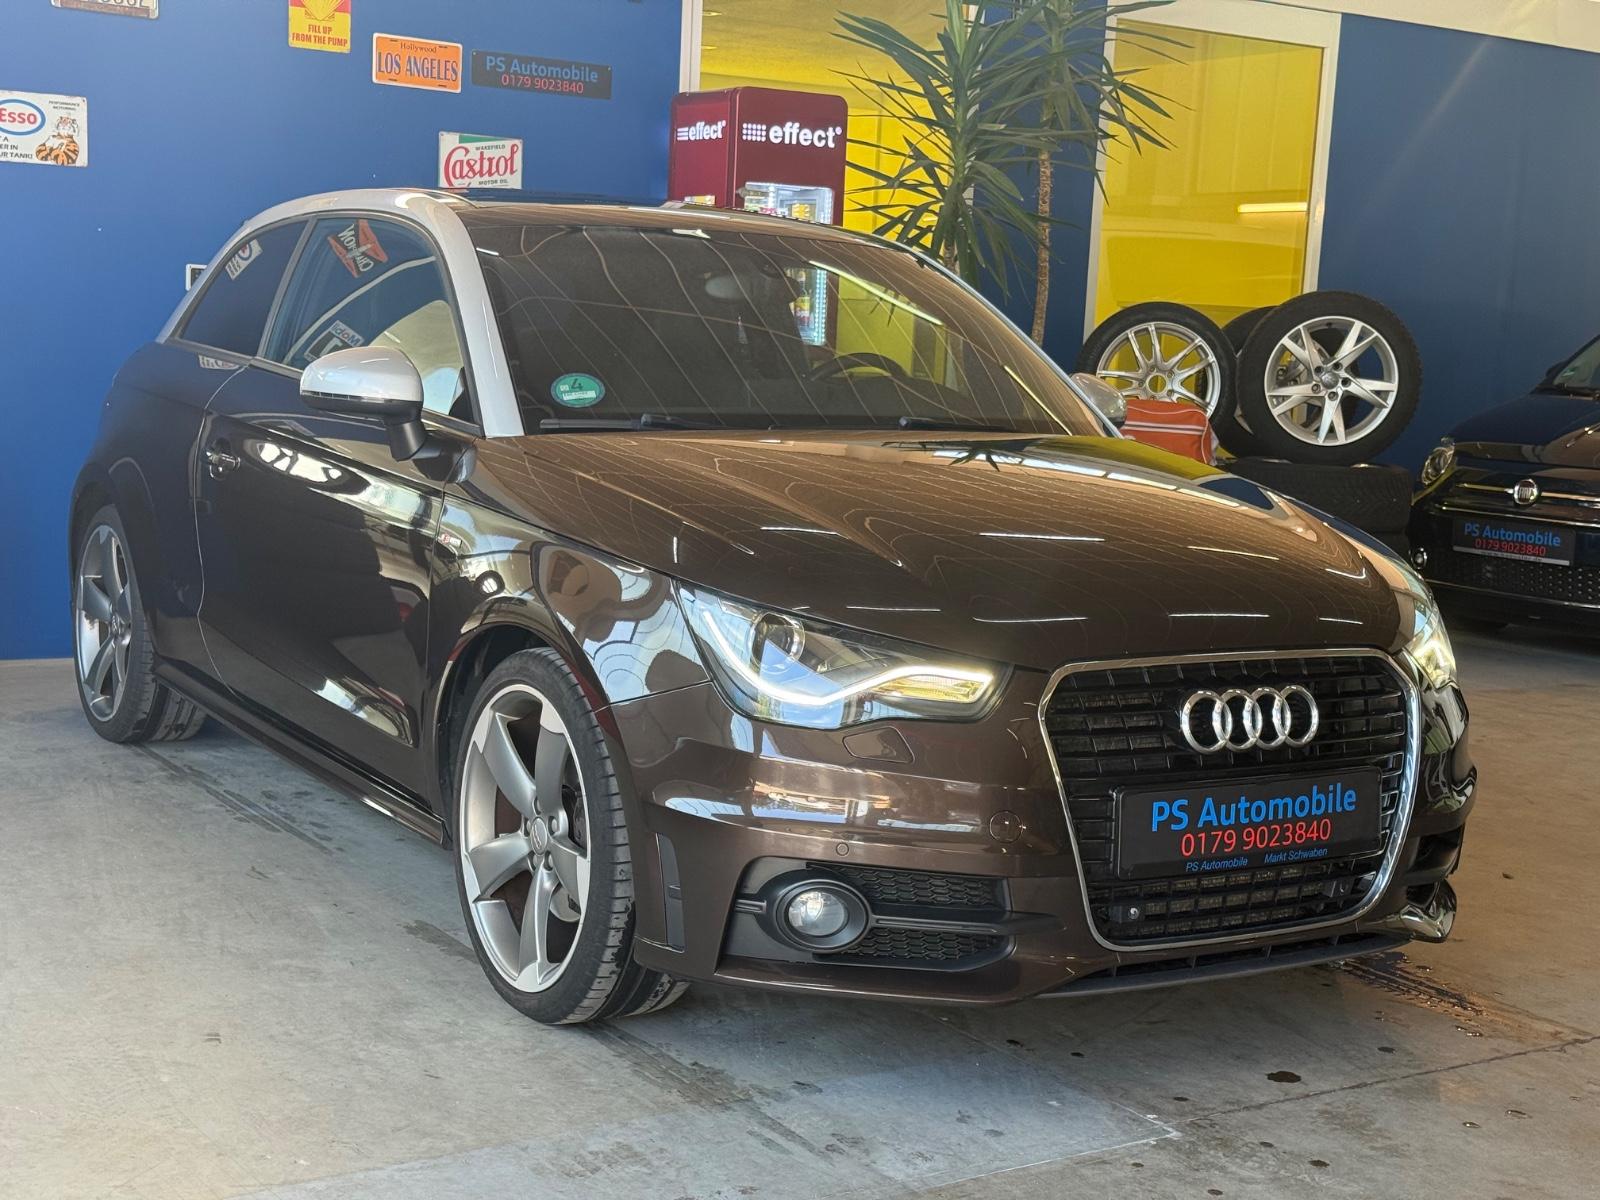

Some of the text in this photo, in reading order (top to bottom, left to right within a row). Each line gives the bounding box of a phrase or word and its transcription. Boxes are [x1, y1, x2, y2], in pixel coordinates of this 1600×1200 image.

[292, 32, 348, 47] FROM THE PUMP
[308, 24, 332, 35] FILL UP
[400, 42, 437, 53] Hollywood
[378, 51, 458, 82] LOS ANGELES
[486, 55, 598, 82] PS Automobile
[501, 74, 584, 94] 0179 9023840
[689, 120, 723, 140] effect
[769, 121, 835, 148] effect
[444, 143, 519, 187] Castrol
[571, 378, 583, 390] 4
[1464, 522, 1561, 547] PS Automobile
[1475, 538, 1500, 550] 0179
[1501, 541, 1546, 557] 9023840
[1151, 782, 1357, 832] PS Automobile
[1181, 819, 1332, 857] 0179 9023840
[1185, 857, 1248, 872] PS Automobile
[1264, 847, 1328, 864] Markt Schwaben
